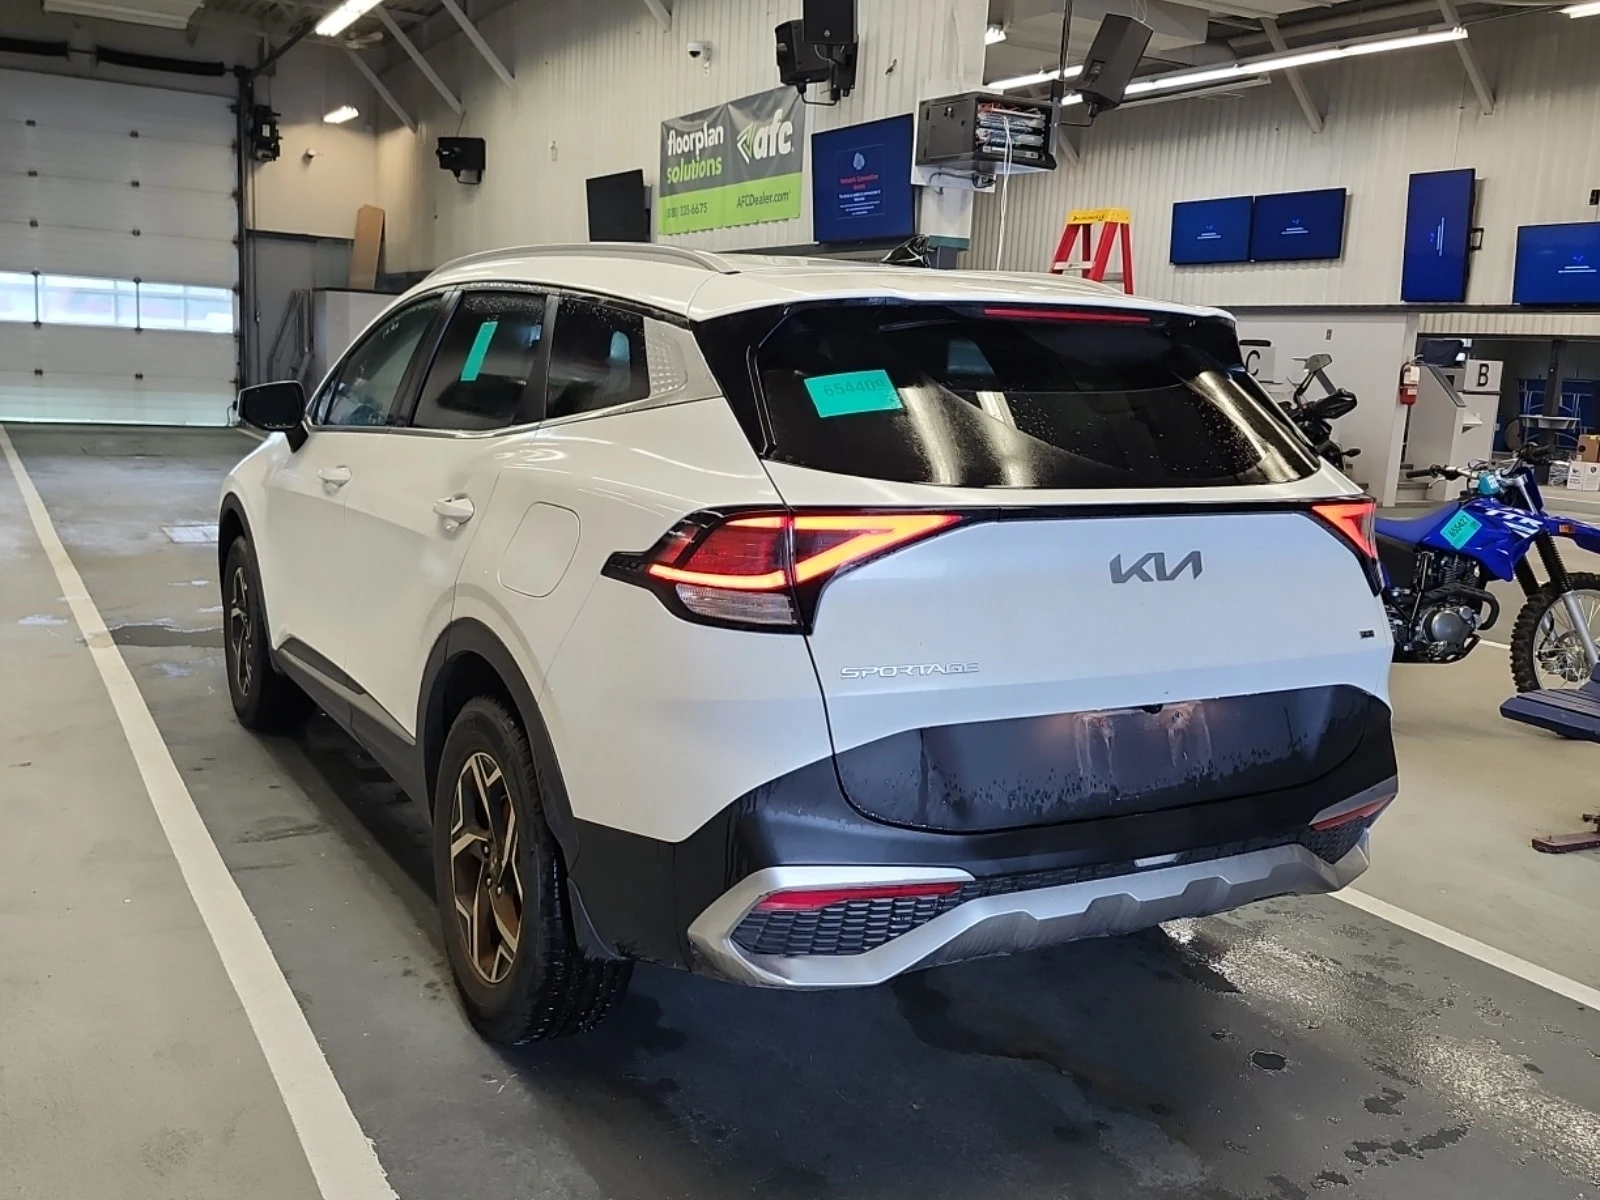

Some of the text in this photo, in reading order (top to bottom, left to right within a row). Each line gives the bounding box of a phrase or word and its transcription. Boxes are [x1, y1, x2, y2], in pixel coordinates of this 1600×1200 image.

[667, 121, 724, 156] floorplan
[753, 108, 793, 160] afc
[666, 156, 723, 184] solutions
[736, 190, 789, 209] AFCDealer.com
[1246, 349, 1261, 377] C
[1477, 363, 1490, 387] B
[823, 379, 886, 397] 654409
[1109, 550, 1204, 584] KIA
[839, 662, 980, 679] SPORTAGE
